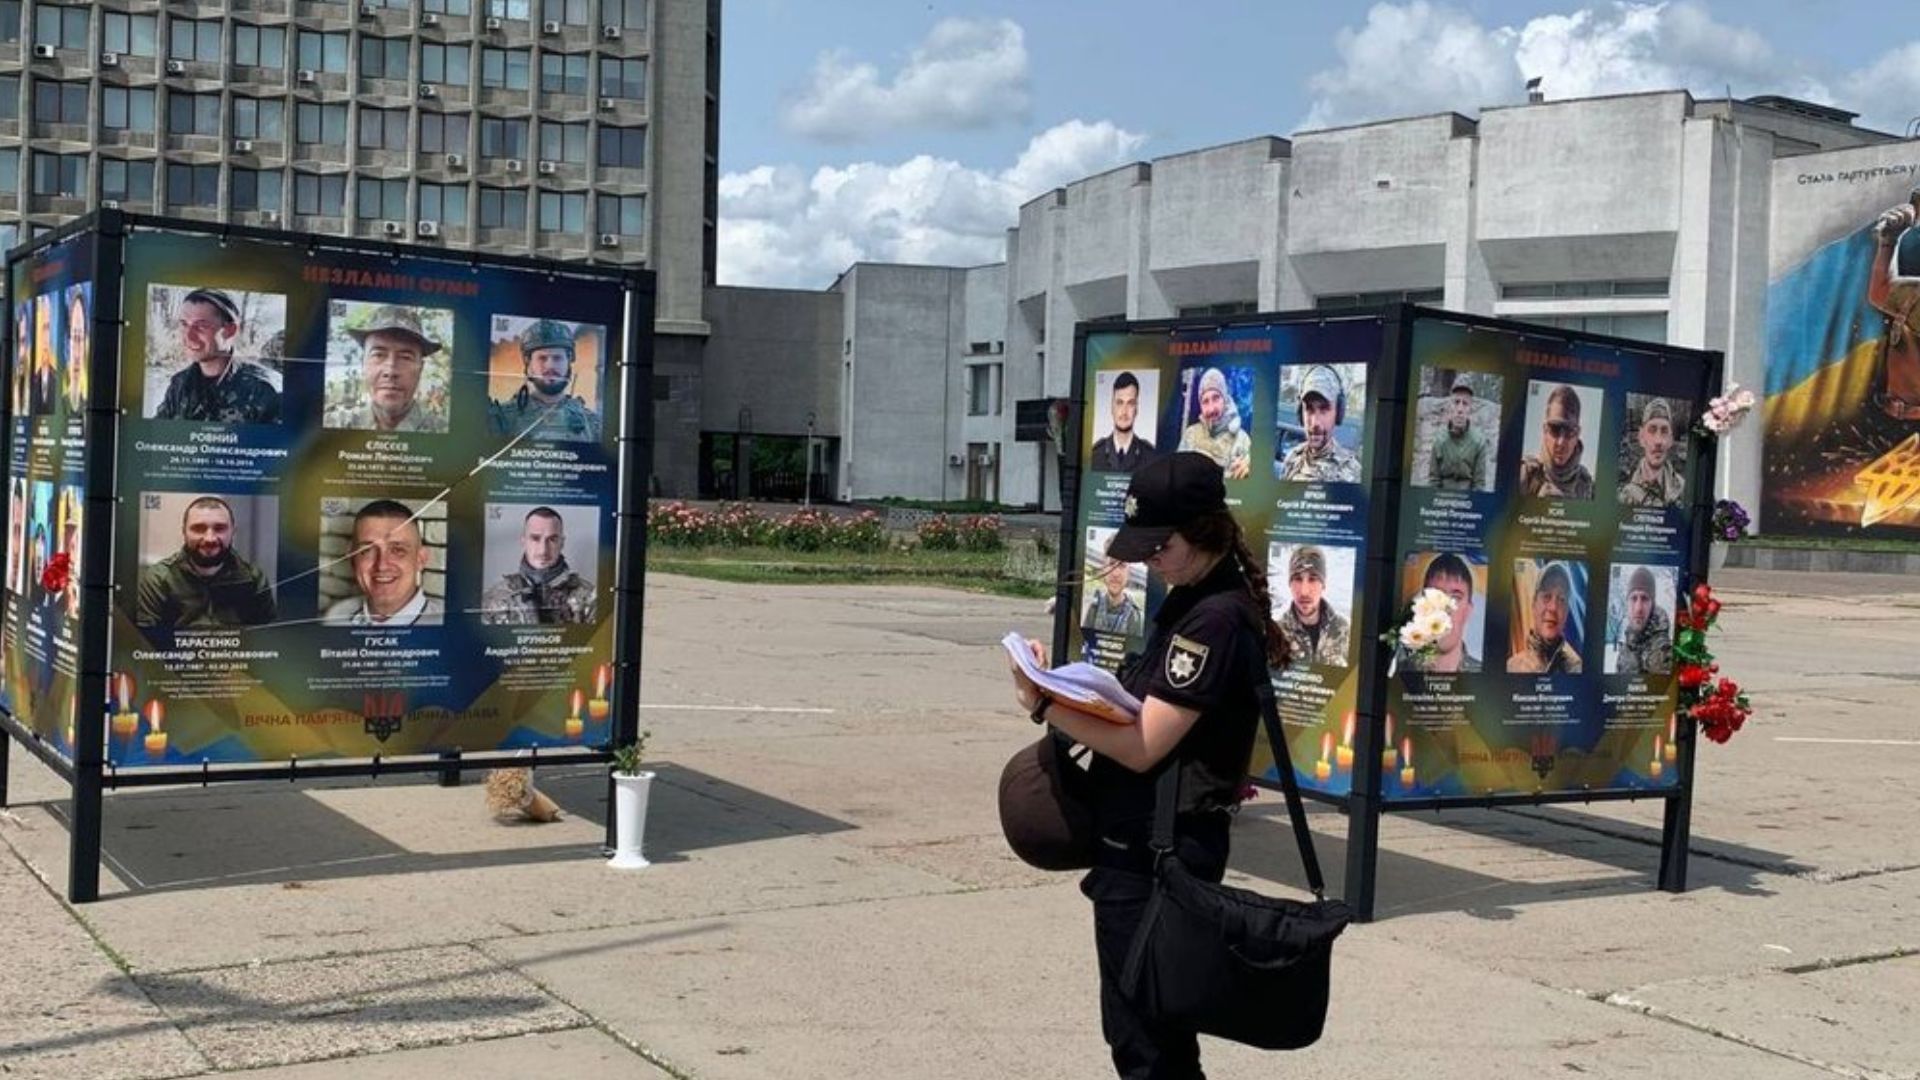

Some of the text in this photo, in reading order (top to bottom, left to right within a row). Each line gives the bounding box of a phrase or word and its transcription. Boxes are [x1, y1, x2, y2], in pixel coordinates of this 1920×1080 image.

[418, 277, 479, 295] СУМИ
[135, 440, 288, 458] Олександр Олександрович
[338, 450, 373, 460] Роман
[174, 637, 241, 648] ТАРАСЕНКО
[365, 637, 399, 647] ГУСАК
[132, 649, 279, 661] Олександр Станіславович
[320, 648, 440, 659] Віталій Олександрович
[485, 646, 519, 657] Андрій
[245, 714, 291, 727] ВІЧНА
